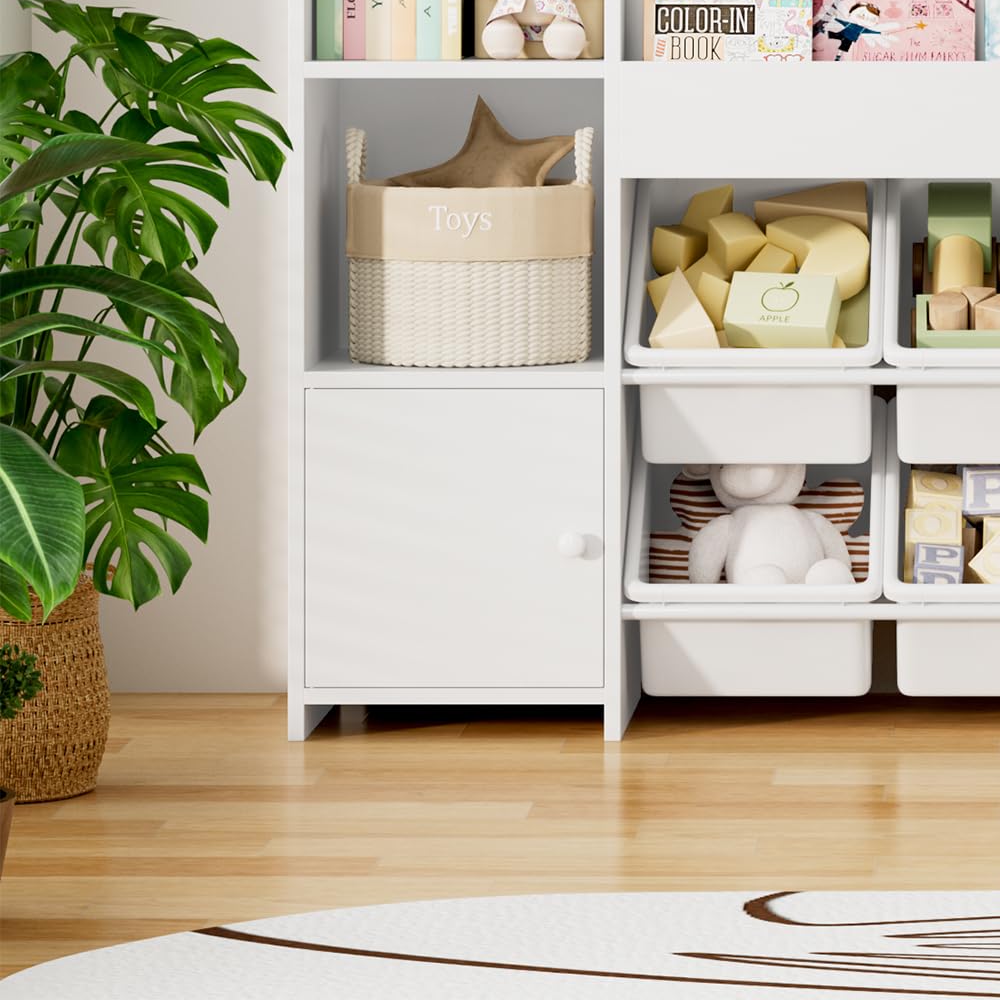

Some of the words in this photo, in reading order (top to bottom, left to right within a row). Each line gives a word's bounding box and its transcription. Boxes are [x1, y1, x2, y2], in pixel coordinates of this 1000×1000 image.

[423, 5, 431, 18] A
[670, 35, 722, 61] BOOK
[428, 205, 493, 239] Toys
[759, 314, 791, 324] APPLE
[922, 546, 958, 563] P
